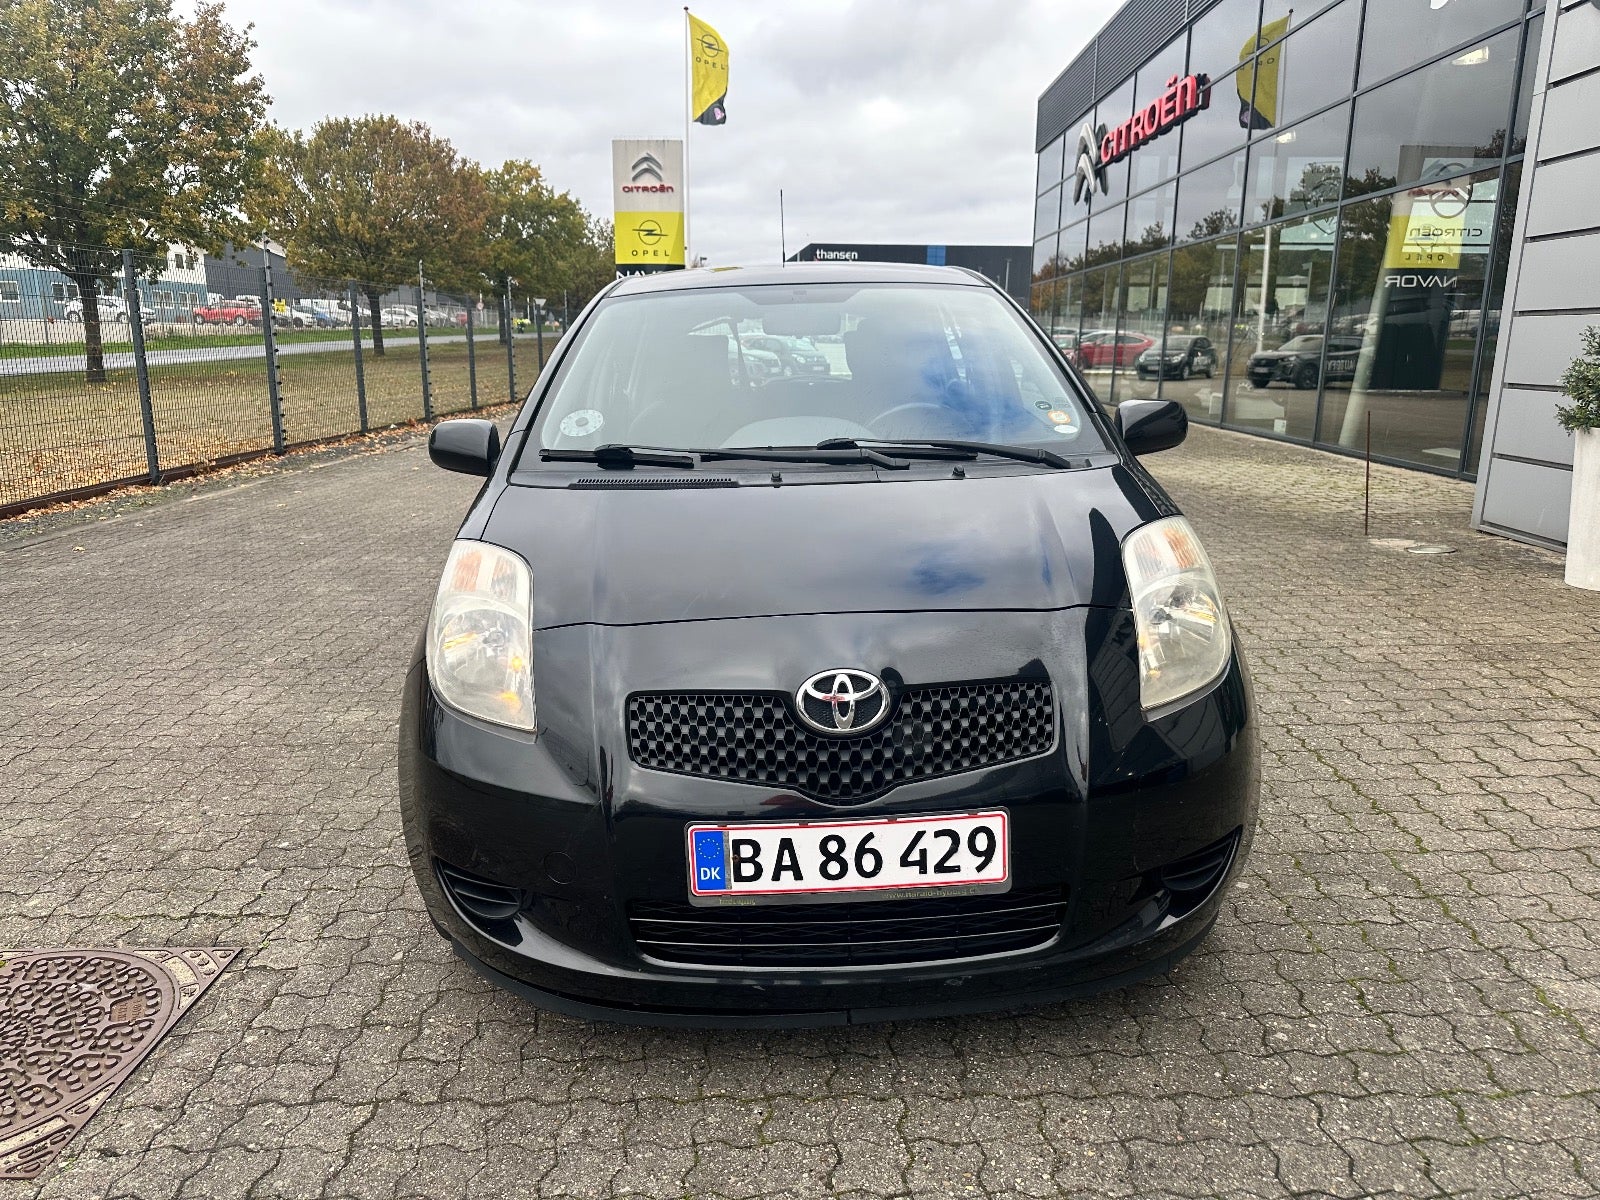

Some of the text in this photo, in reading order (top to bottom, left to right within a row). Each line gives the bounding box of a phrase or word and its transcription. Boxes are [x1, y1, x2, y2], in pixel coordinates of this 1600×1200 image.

[695, 56, 725, 70] OPEL
[1101, 74, 1197, 164] CITROËN
[622, 184, 674, 193] CITROËN
[631, 249, 670, 257] OPEL
[816, 248, 858, 260] thansen
[732, 824, 997, 883] BA 86 429
[700, 867, 721, 881] DK
